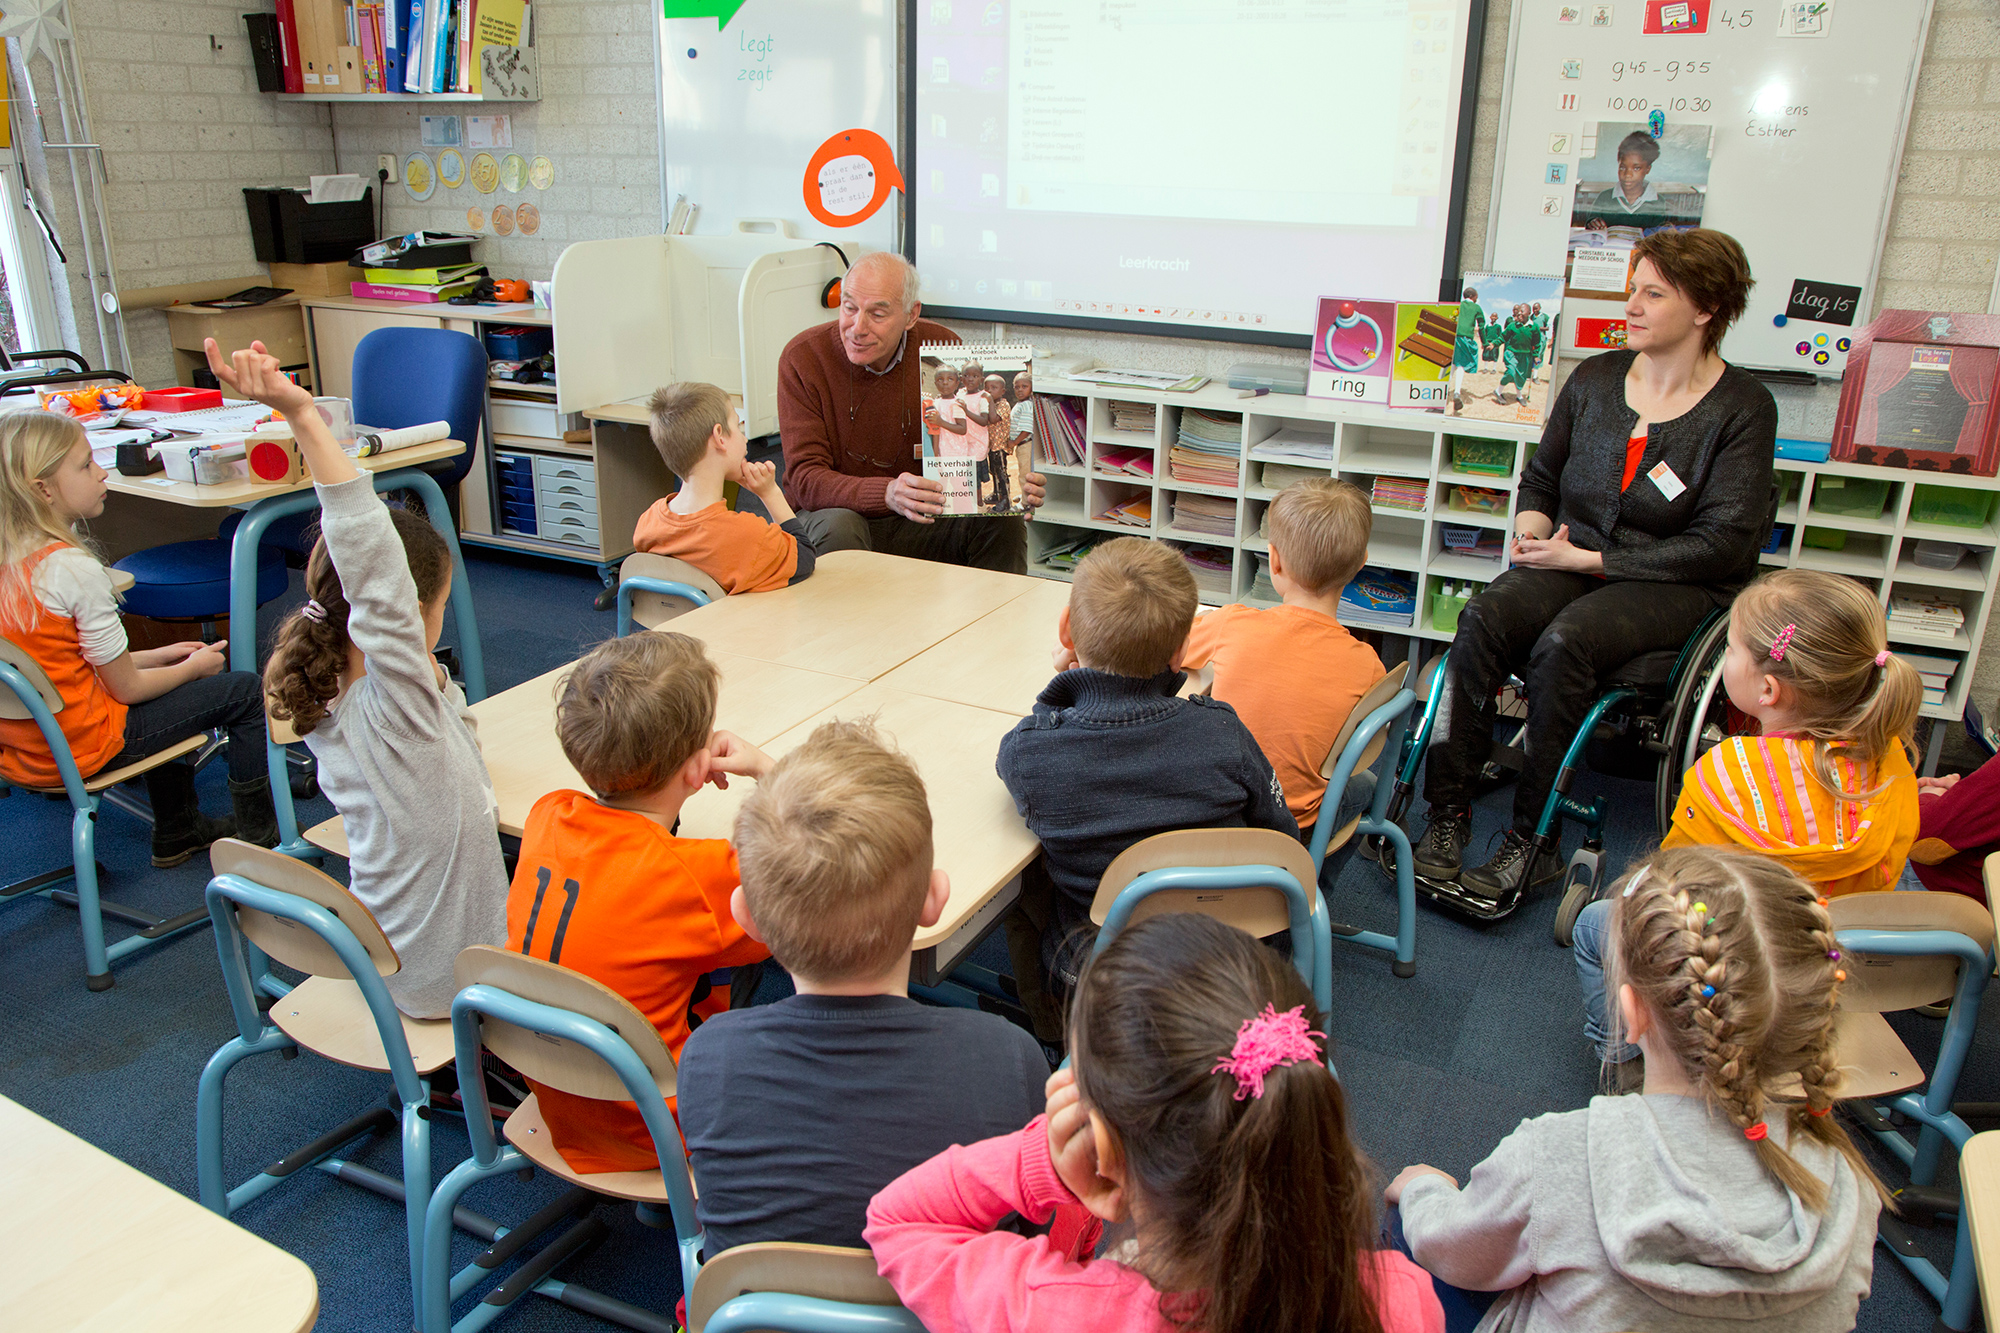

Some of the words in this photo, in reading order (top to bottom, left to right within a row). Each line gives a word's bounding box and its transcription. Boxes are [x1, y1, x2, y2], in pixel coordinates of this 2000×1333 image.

[740, 30, 774, 62] legt
[737, 64, 773, 92] zegt
[1607, 97, 1648, 112] 10.00
[1669, 97, 1712, 112] 10.30
[1745, 120, 1797, 138] Esther
[825, 177, 846, 187] praat
[829, 197, 845, 205] rest
[1119, 254, 1190, 272] Leerkracht
[1793, 286, 1830, 319] dag
[1833, 296, 1856, 312] 15
[1919, 354, 1944, 362] lezen
[1332, 376, 1365, 397] ring
[1516, 413, 1536, 422] Fonds
[1517, 406, 1540, 415] Liliane
[522, 866, 580, 964] 11
